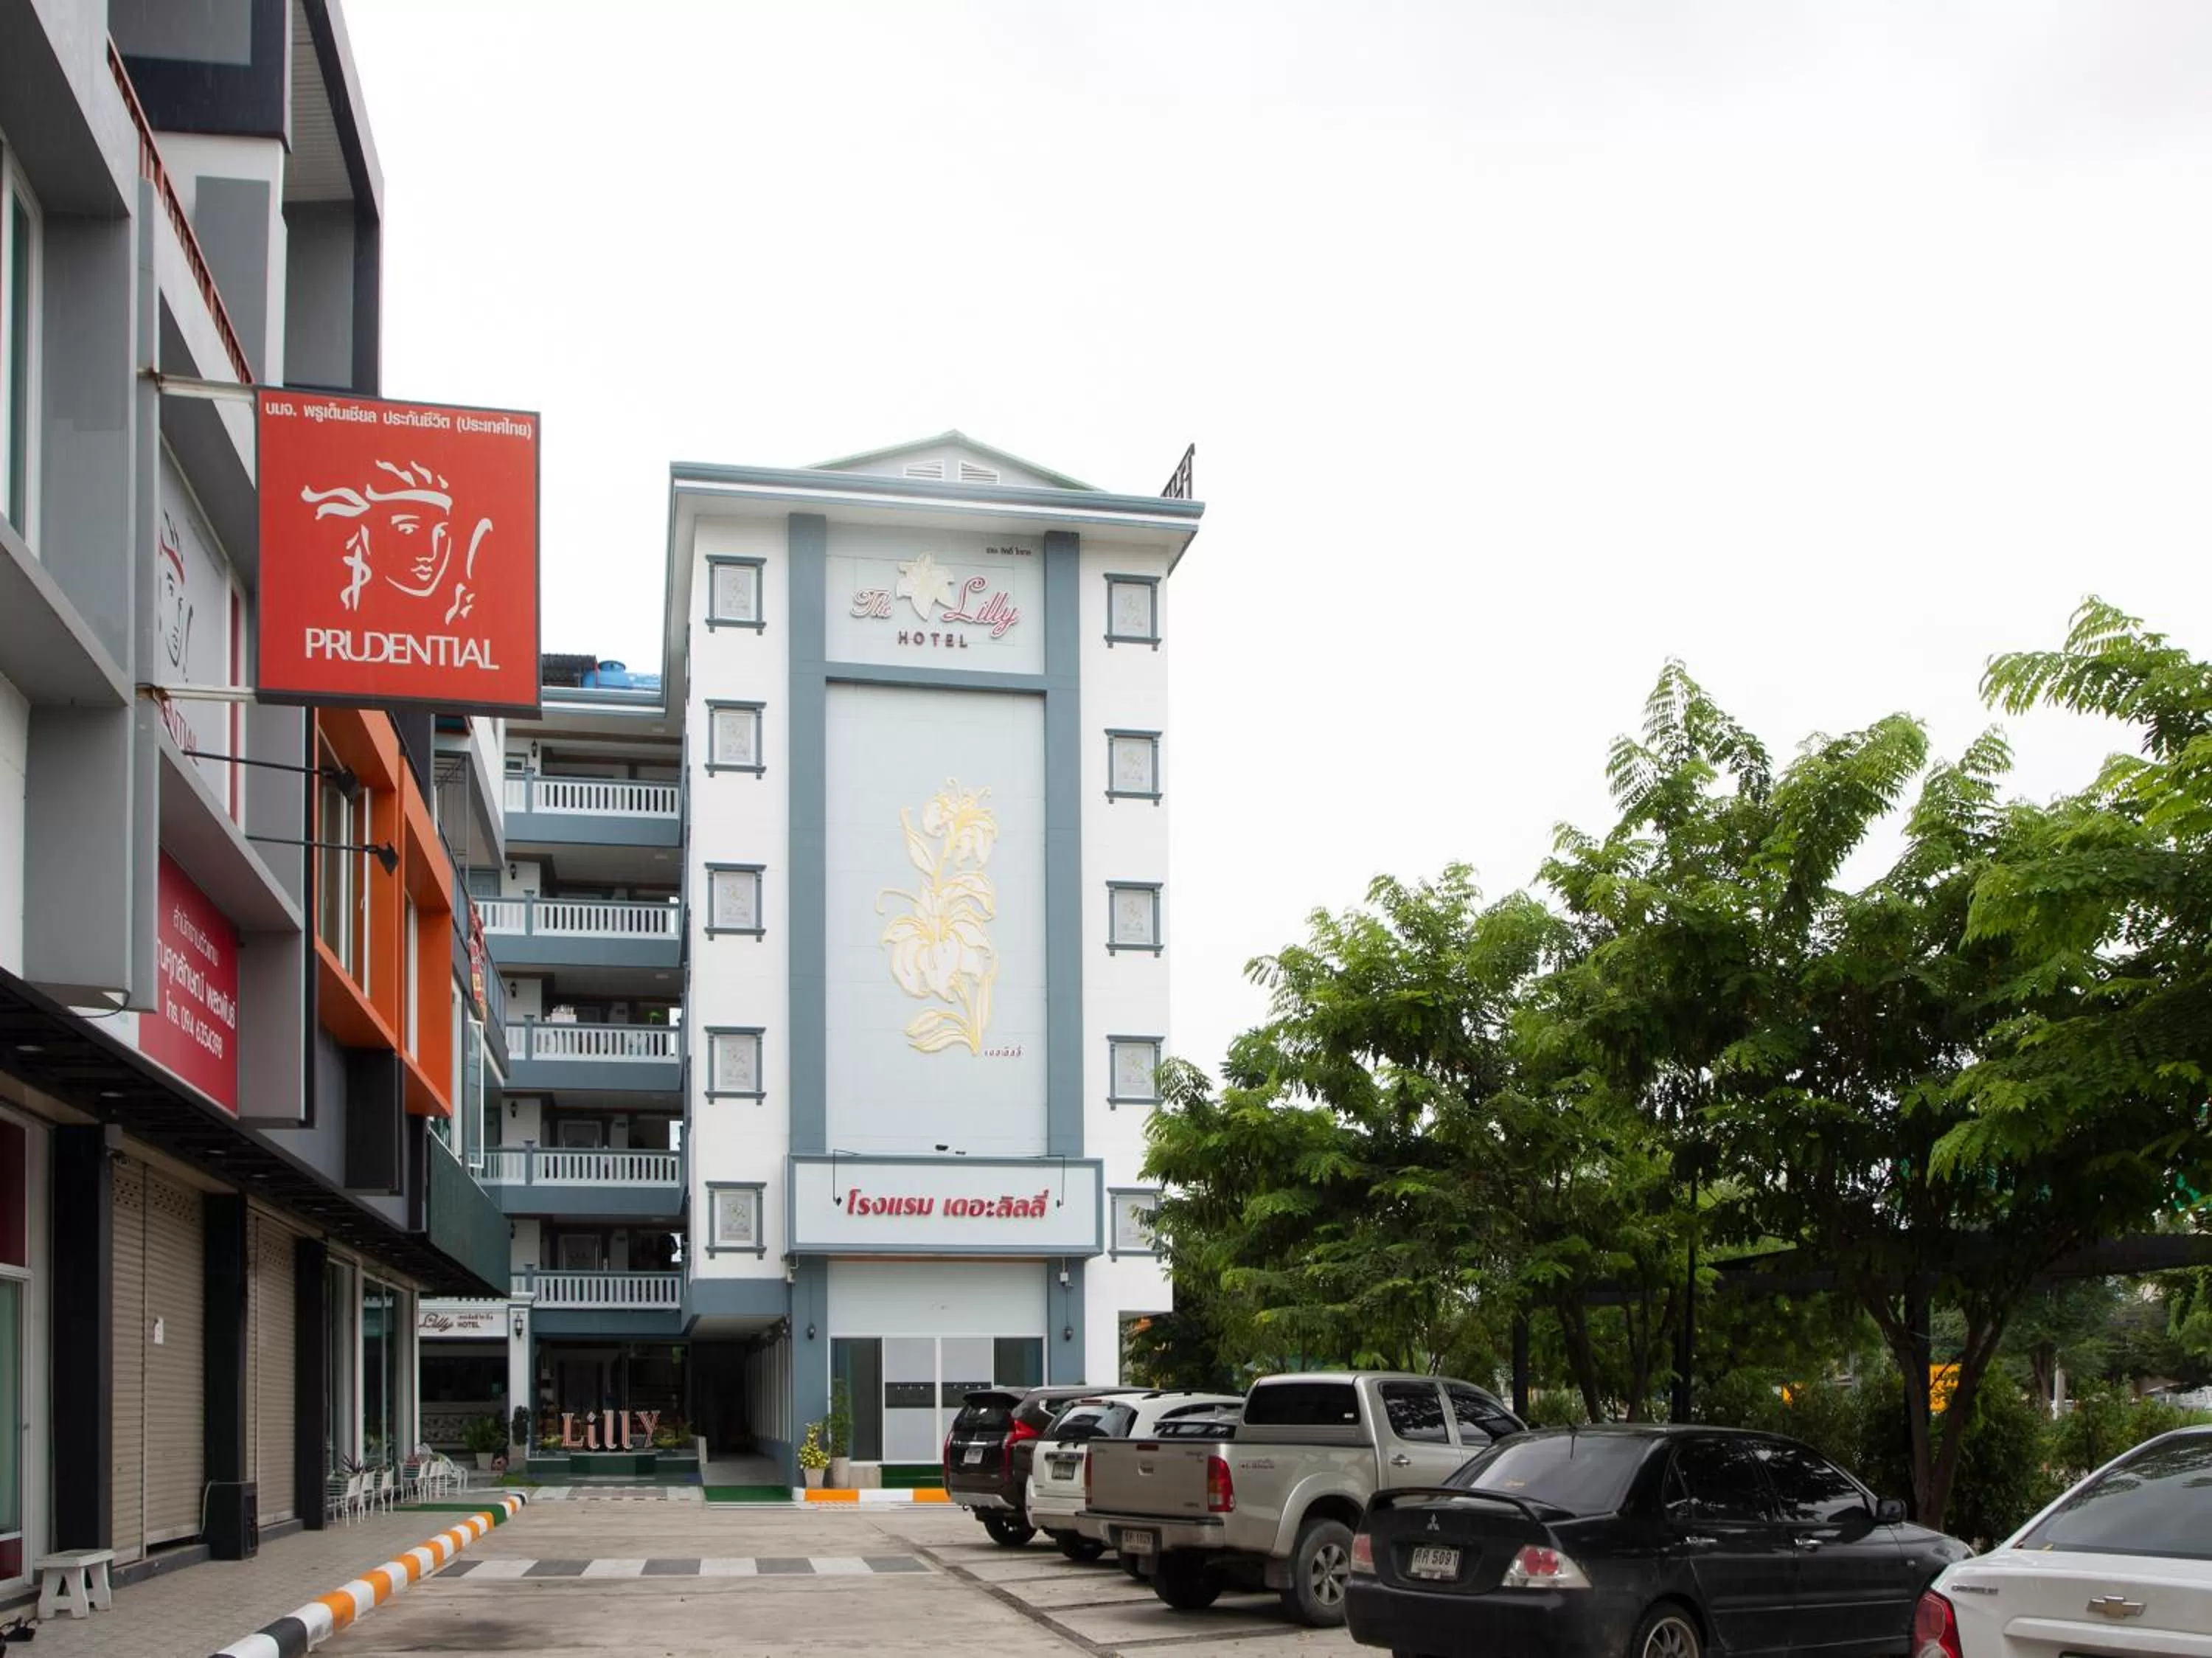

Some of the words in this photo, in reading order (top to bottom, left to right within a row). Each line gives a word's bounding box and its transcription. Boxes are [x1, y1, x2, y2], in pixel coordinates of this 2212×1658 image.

[265, 401, 297, 417] บมจ.
[383, 410, 451, 429] ประกันชีวิต
[456, 416, 532, 440] (ประเทศไทย)
[850, 588, 893, 618] The
[940, 575, 1020, 639] Lilly
[305, 627, 501, 670] PRUDENTIAL
[898, 631, 968, 649] HOTEL
[166, 989, 180, 1026] โทร.
[847, 1188, 935, 1216] โรงแรม
[943, 1190, 1049, 1218] เดอะลิลลี่
